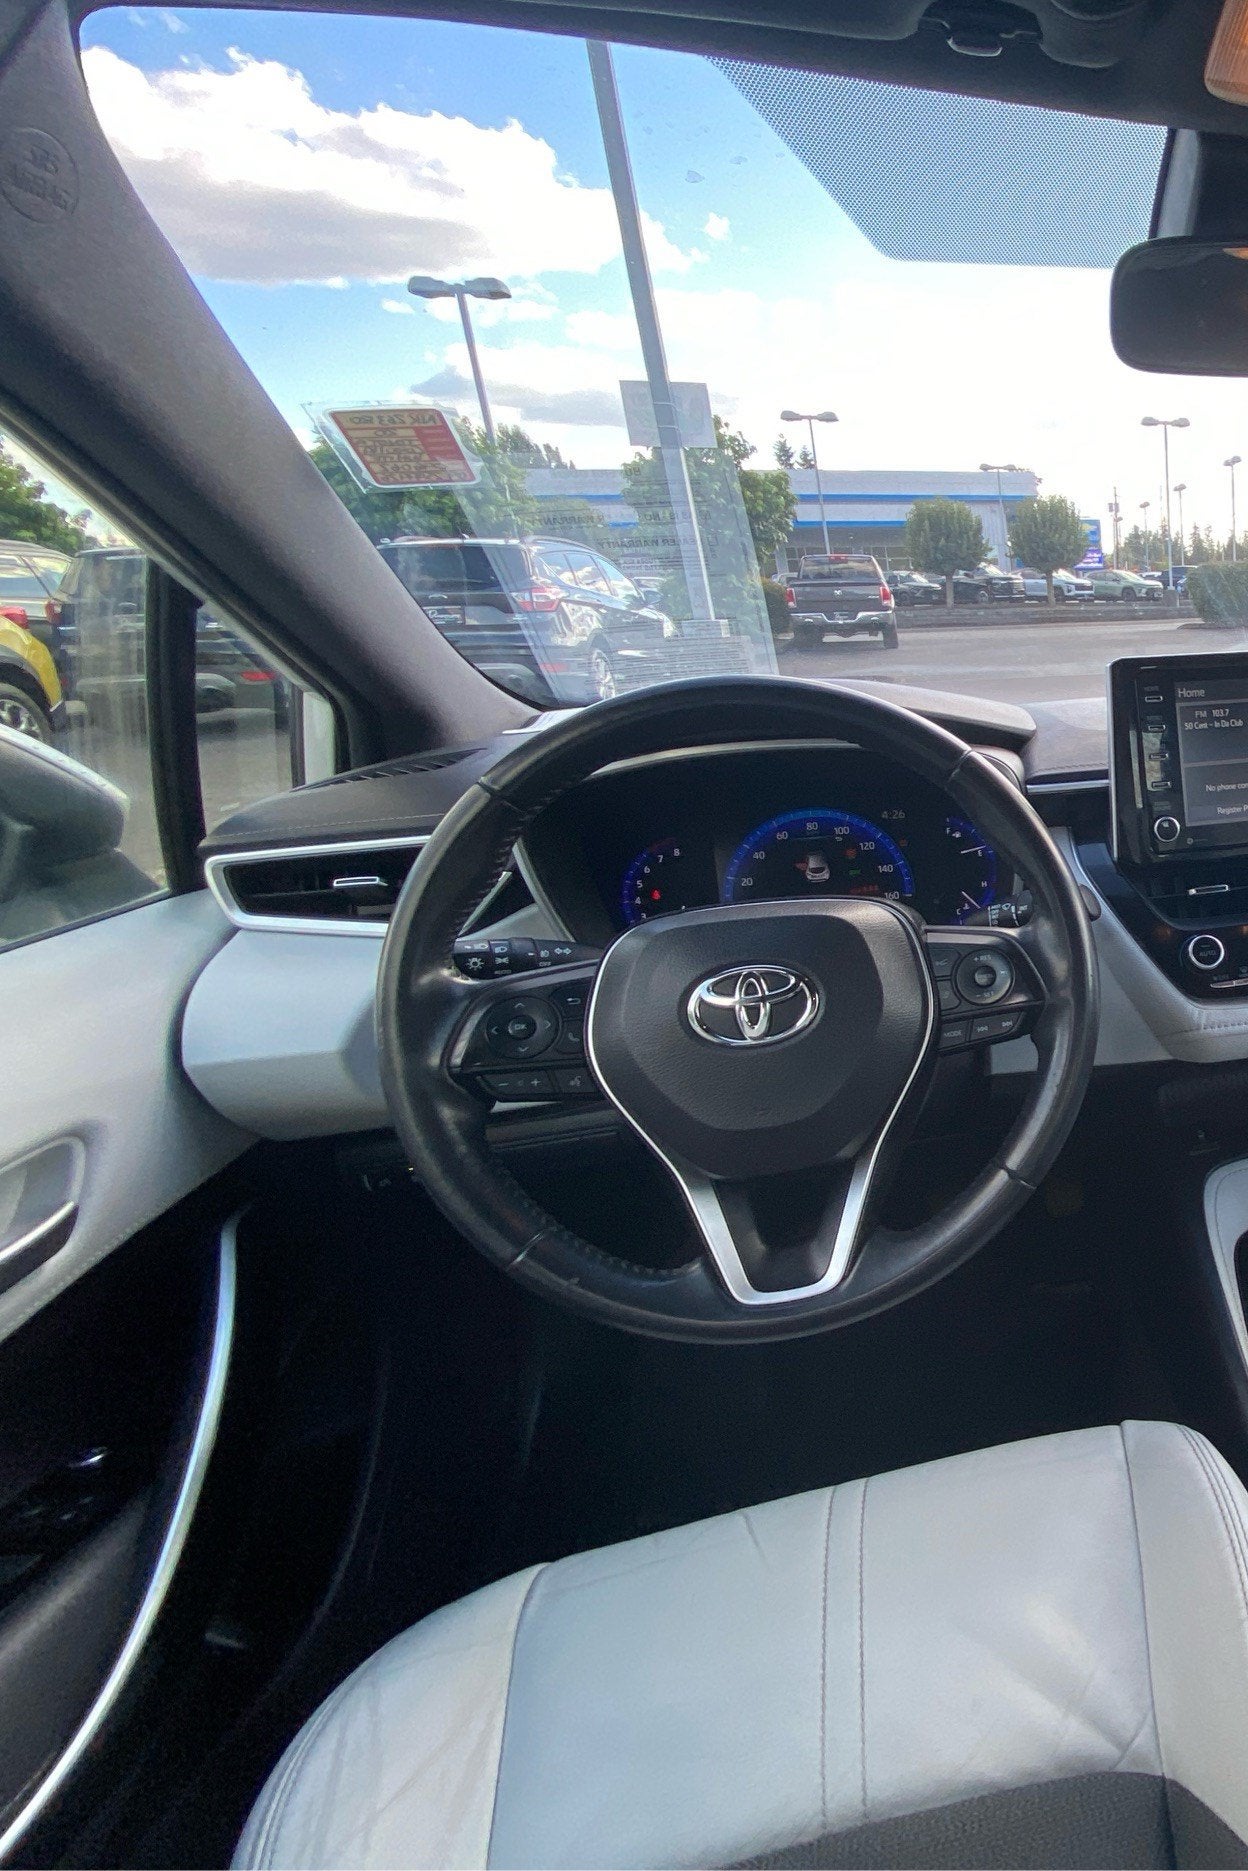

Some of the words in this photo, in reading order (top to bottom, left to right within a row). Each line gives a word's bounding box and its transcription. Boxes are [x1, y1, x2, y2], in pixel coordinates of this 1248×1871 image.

[1177, 687, 1205, 698] Home
[1195, 710, 1207, 718] FM
[1212, 708, 1230, 717] 103.7
[1184, 722, 1193, 730] 50
[1194, 721, 1208, 729] Cent
[1230, 719, 1244, 727] Club
[1205, 784, 1216, 792] No
[1217, 783, 1236, 792] phone
[882, 809, 906, 819] 4:26
[1217, 806, 1242, 815] Register
[806, 821, 818, 831] 80
[834, 826, 850, 835] 100
[776, 831, 788, 840] 60
[860, 841, 875, 851] 120
[673, 848, 680, 857] 8
[753, 851, 765, 860] 40
[978, 849, 983, 857] E
[657, 854, 664, 863] 7
[644, 865, 651, 874] 6
[878, 864, 894, 873] 140
[636, 880, 643, 888] 5
[741, 877, 753, 887] 20
[884, 891, 900, 900] 160
[635, 896, 641, 905] 4
[956, 907, 962, 915] C
